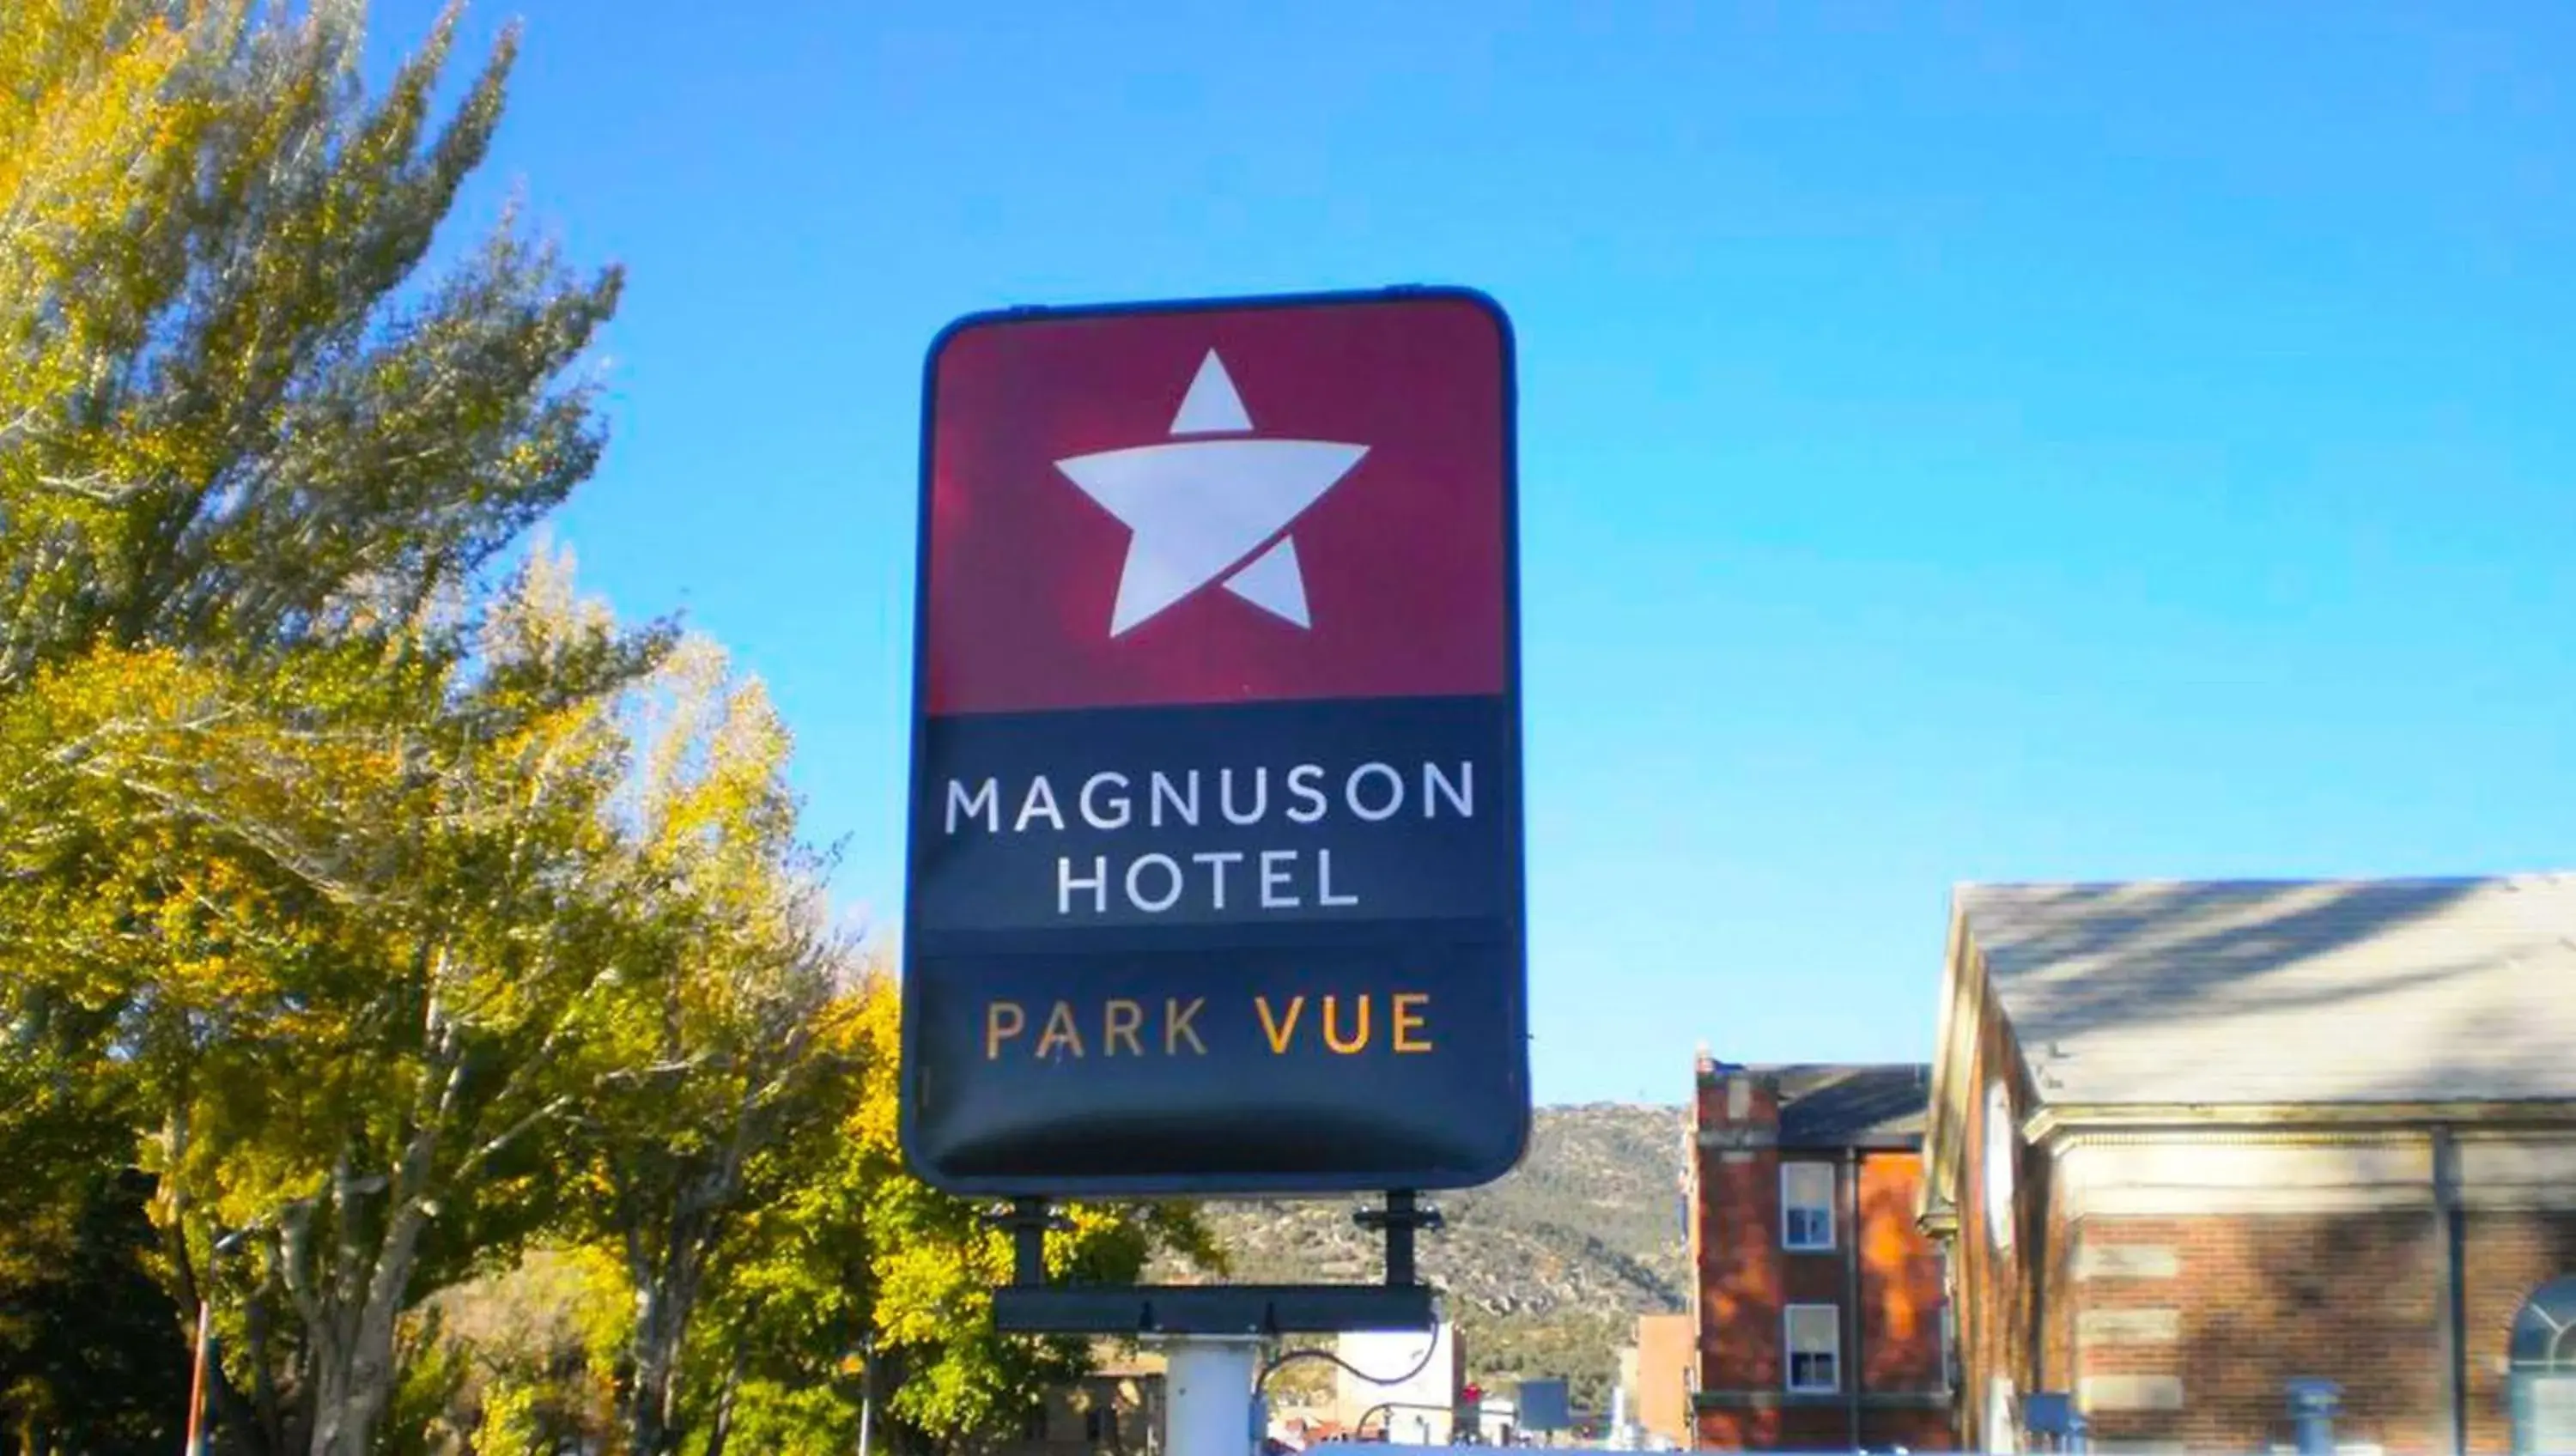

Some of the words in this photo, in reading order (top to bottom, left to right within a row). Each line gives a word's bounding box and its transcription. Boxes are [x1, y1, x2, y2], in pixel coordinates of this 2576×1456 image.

[945, 761, 1474, 834] MAGNUSON
[1057, 848, 1359, 914] HOTEL
[987, 997, 1208, 1060] PARK
[1254, 993, 1433, 1056] VUE
